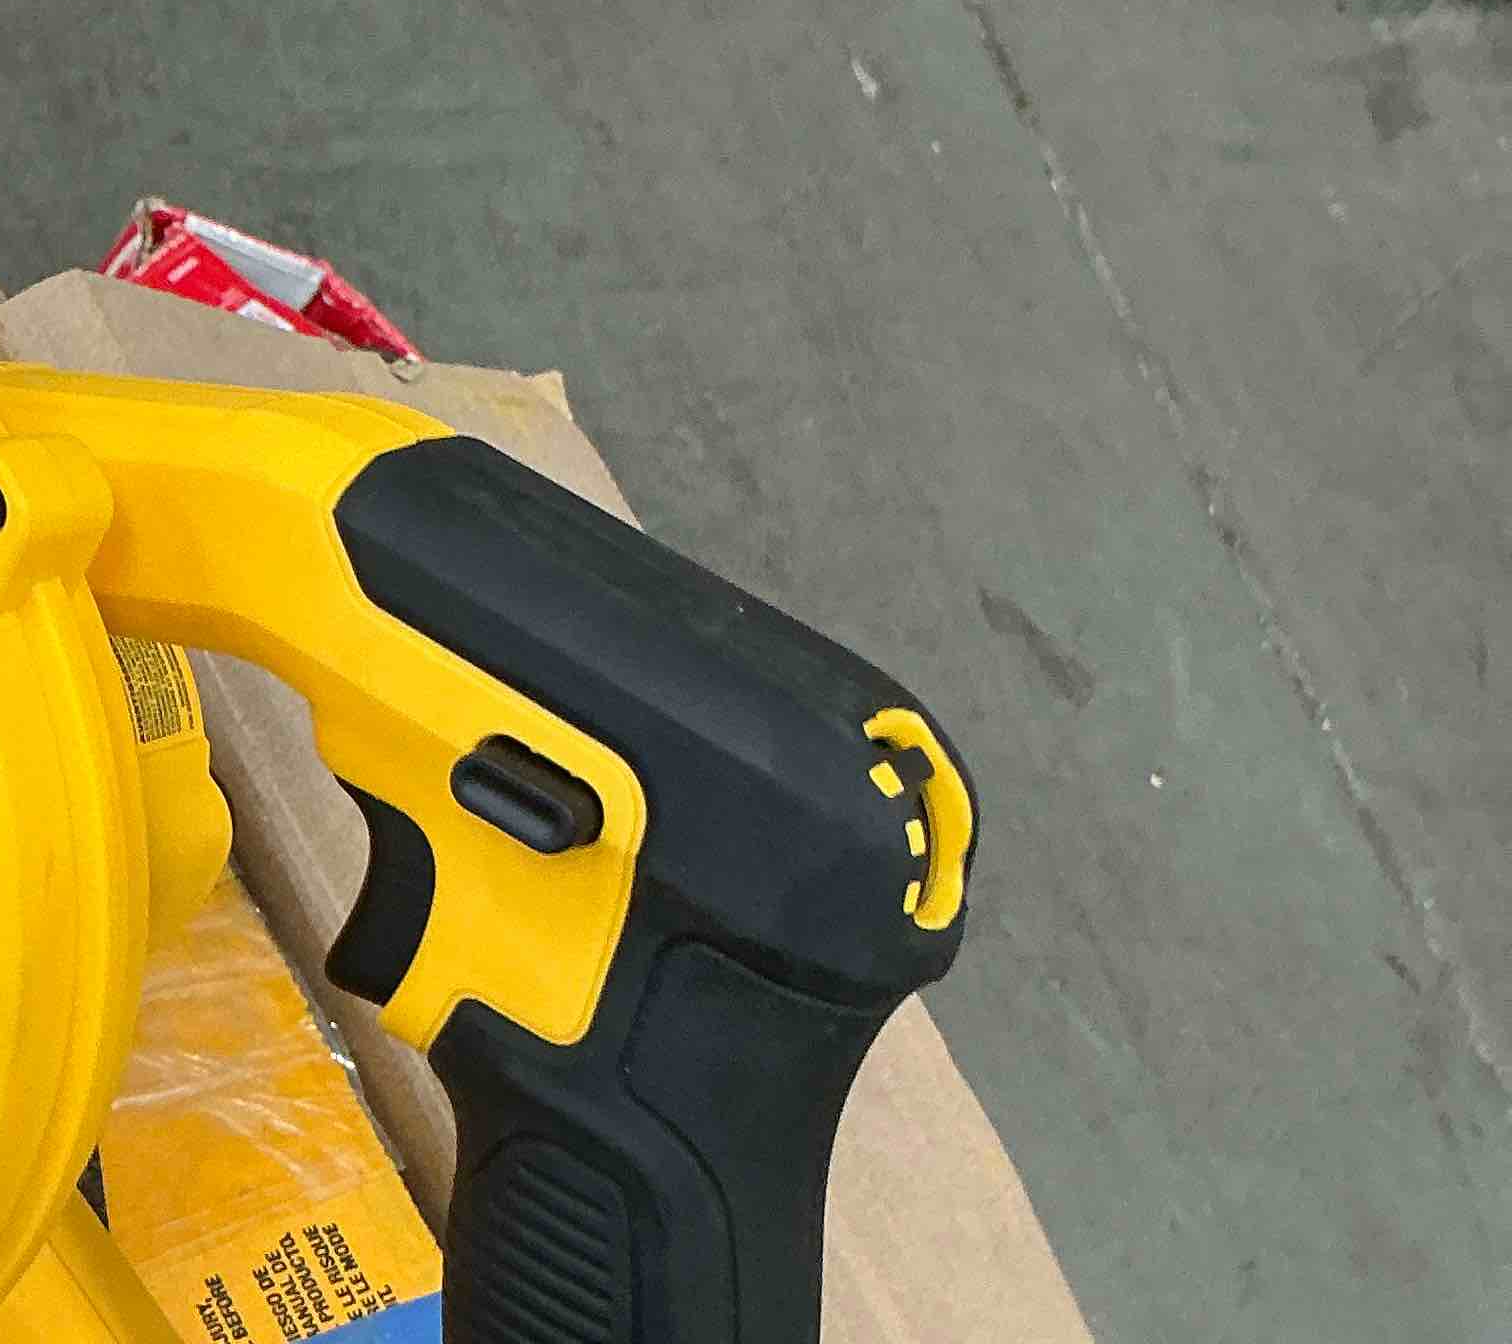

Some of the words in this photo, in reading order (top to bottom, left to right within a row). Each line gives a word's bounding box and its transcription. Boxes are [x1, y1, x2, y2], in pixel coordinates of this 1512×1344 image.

[264, 1248, 287, 1274] DE
[302, 1223, 345, 1287] RISQUE
[321, 1222, 359, 1272] MODE
[252, 1264, 275, 1292] DE
[336, 1286, 357, 1309] LE
[349, 1271, 371, 1295] LE
[203, 1272, 249, 1341] BEFORE
[266, 1291, 301, 1342] IESGO
[280, 1274, 321, 1339] ANUAL
